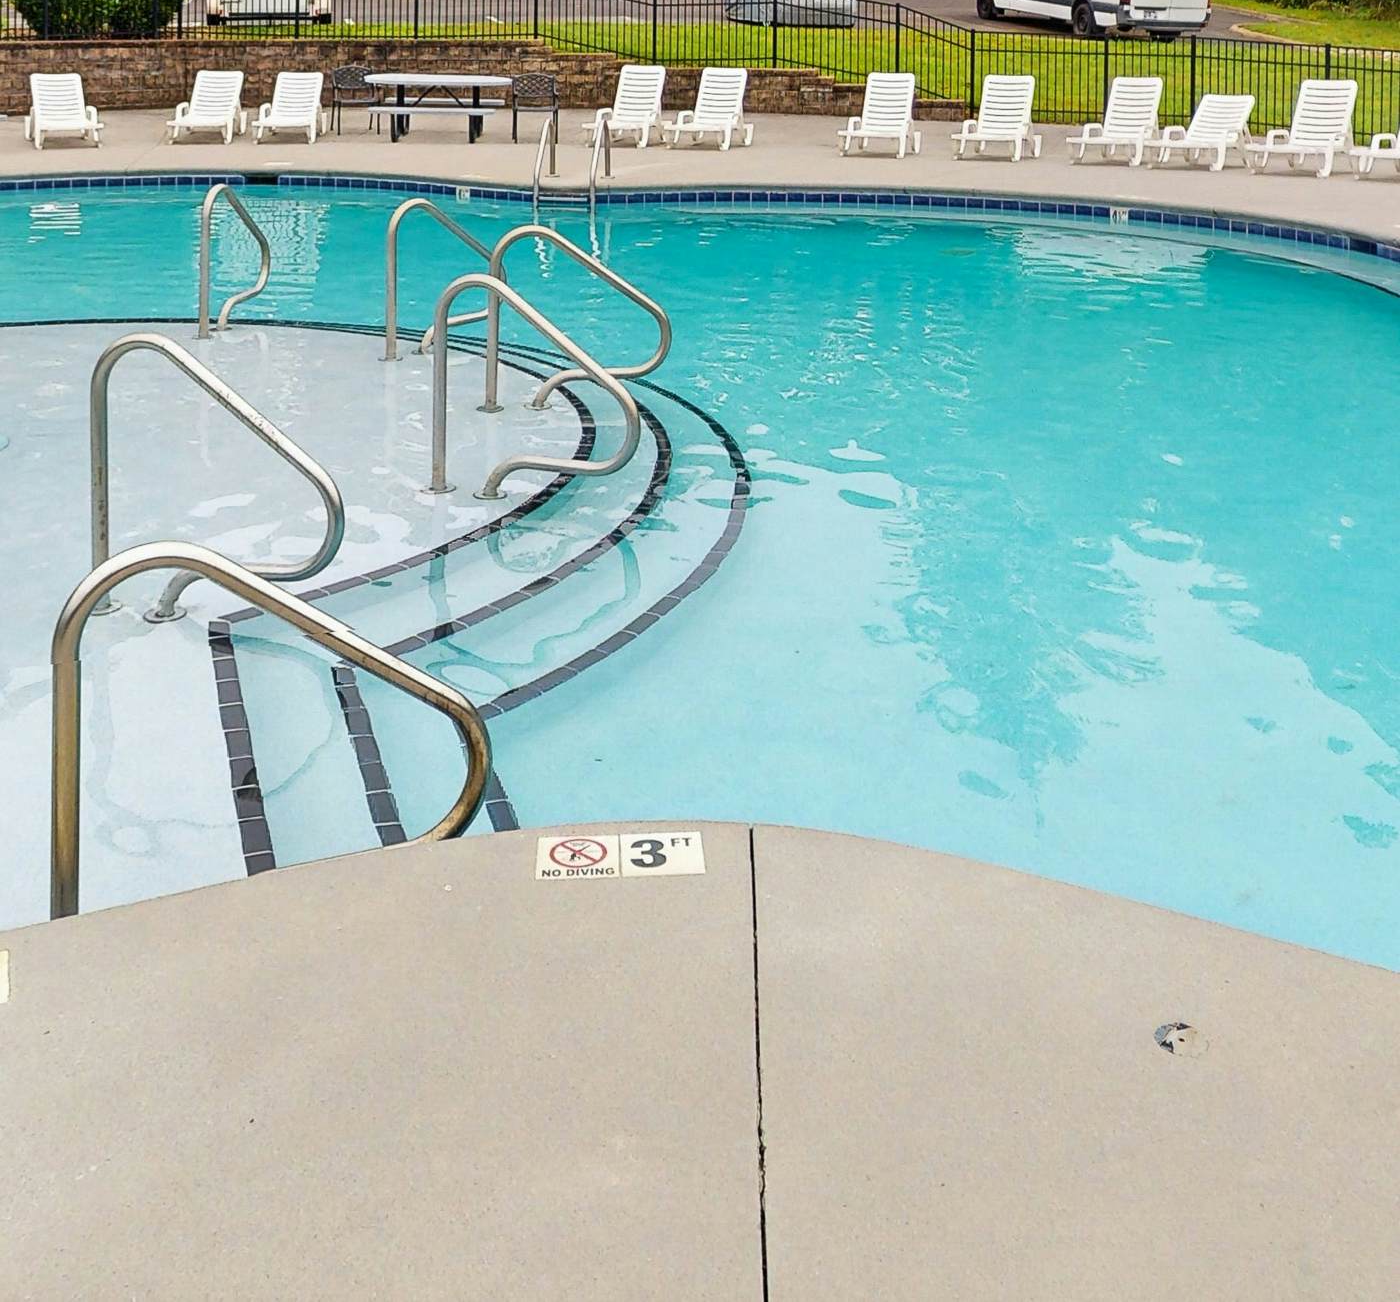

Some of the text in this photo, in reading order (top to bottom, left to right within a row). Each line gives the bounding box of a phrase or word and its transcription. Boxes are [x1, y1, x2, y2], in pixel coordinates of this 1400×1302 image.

[630, 837, 693, 868] 3 FT
[541, 867, 615, 877] NO DIVING
